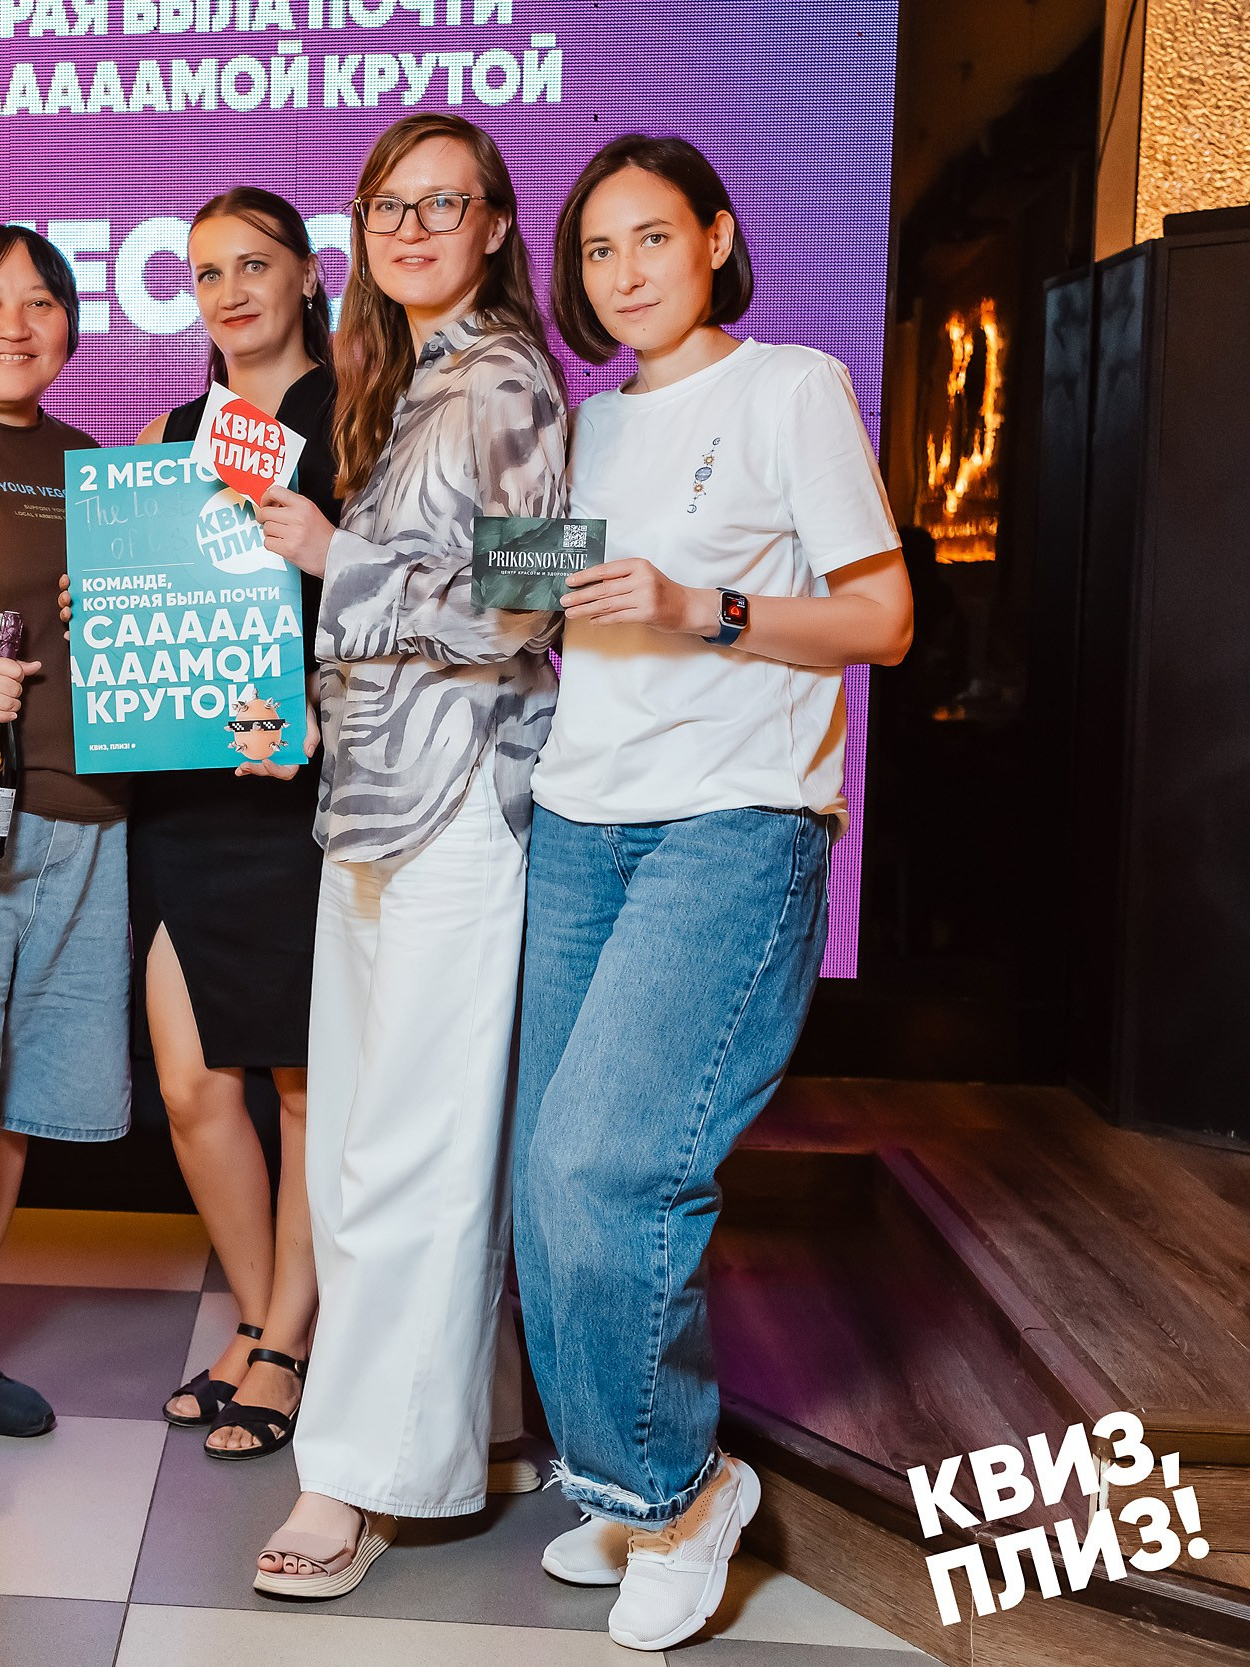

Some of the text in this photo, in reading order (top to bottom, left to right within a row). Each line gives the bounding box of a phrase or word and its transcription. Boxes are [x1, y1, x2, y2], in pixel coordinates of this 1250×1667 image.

[323, 33, 563, 108] КРУТОЙ
[215, 410, 286, 458] КВИЗ,
[211, 437, 284, 481] ПЛИЗ!
[79, 465, 98, 491] 2
[74, 495, 129, 530] The
[197, 500, 256, 538] КВИ
[201, 525, 264, 562] ПЛИ
[488, 550, 588, 570] PRIKOSNOVENIE
[82, 574, 172, 592] КОМАНДЕ,
[82, 587, 280, 611] КОТОРАЯ БЫЛА ПОЧТИ
[83, 605, 302, 649] САААААА
